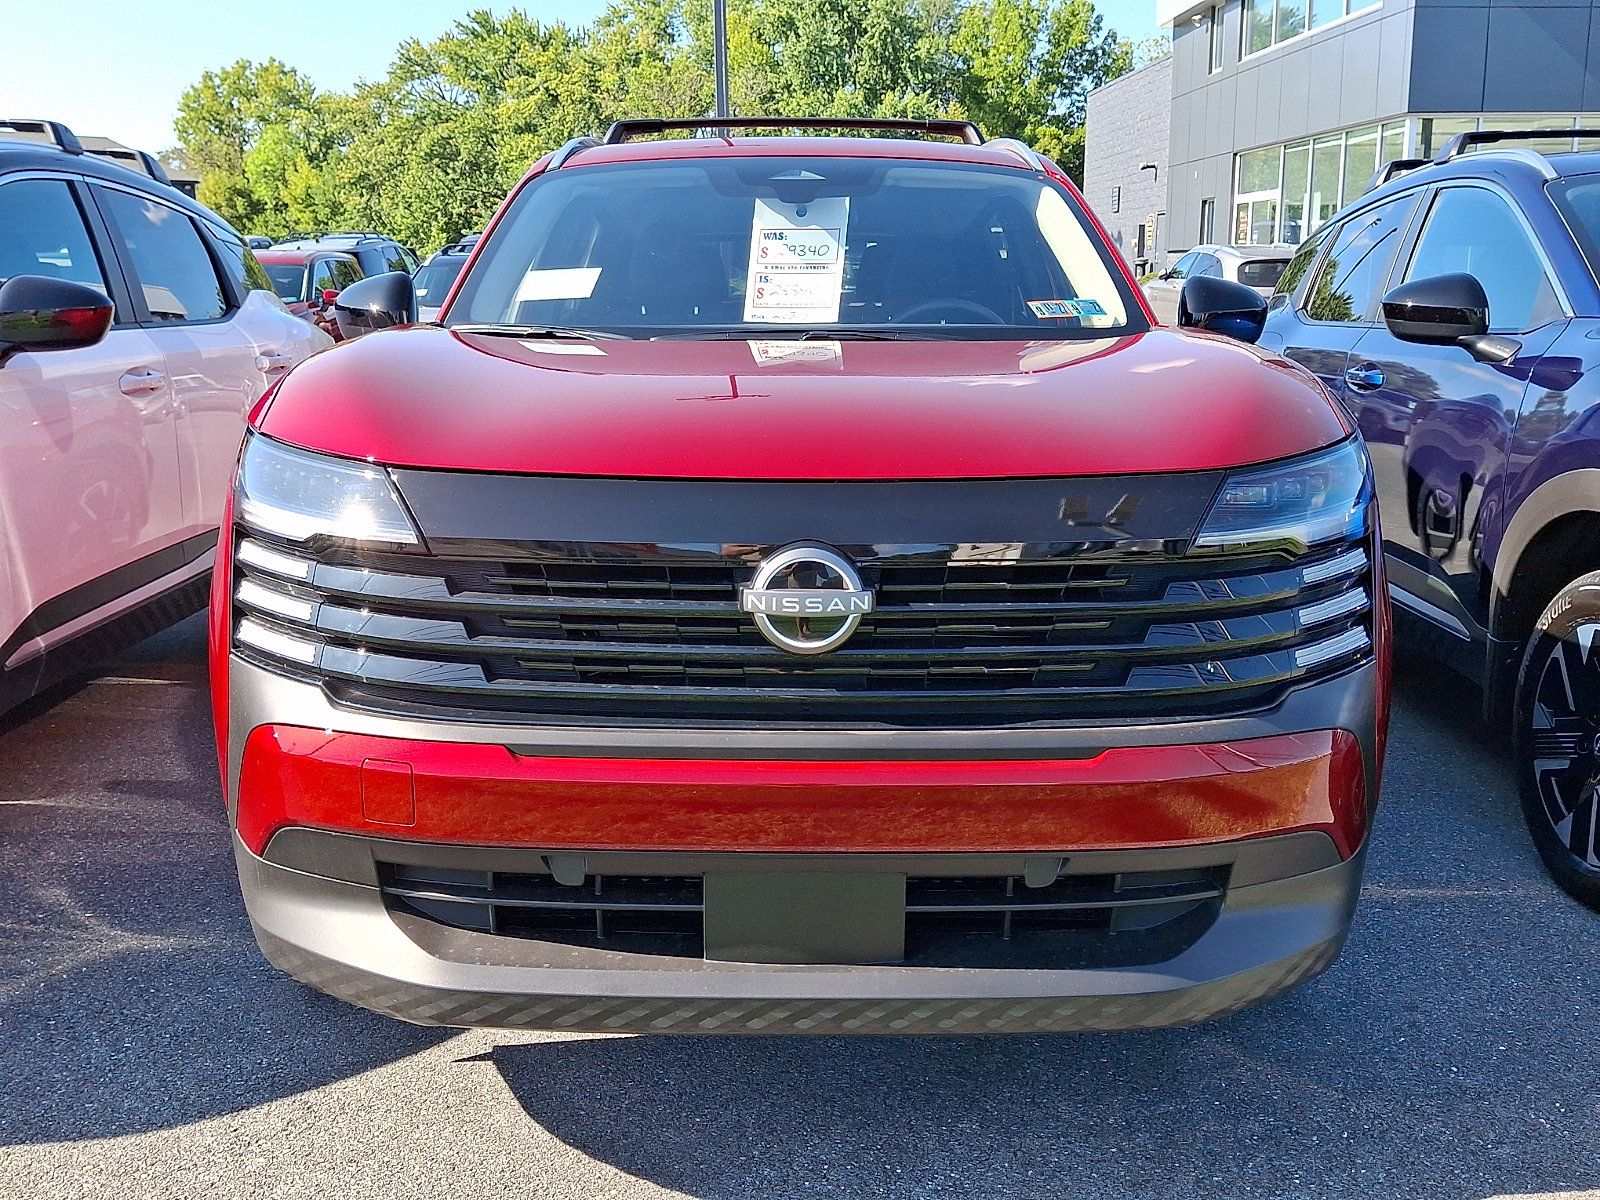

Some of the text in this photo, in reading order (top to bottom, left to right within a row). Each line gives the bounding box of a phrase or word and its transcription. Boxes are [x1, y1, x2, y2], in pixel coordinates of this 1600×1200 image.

[763, 232, 788, 241] WAS:
[758, 275, 773, 284] IS:
[747, 594, 869, 613] NISSAN
